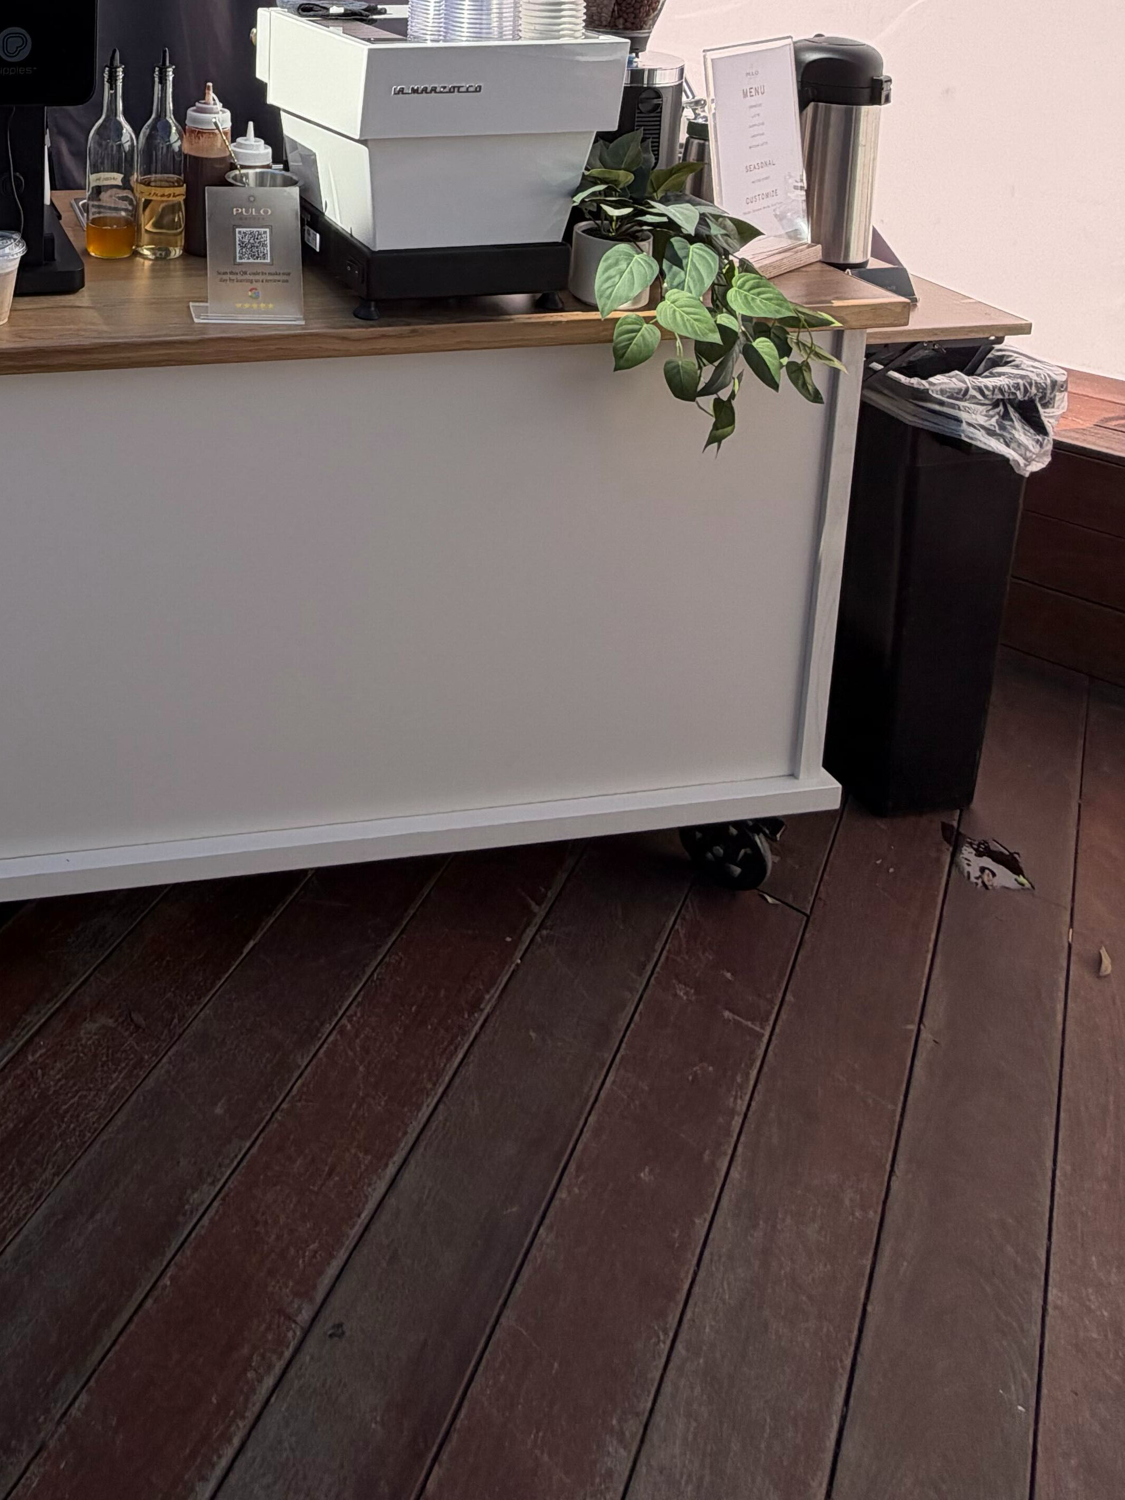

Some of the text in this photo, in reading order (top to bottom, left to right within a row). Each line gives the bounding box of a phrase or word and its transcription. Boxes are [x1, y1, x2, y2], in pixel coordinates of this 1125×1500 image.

[742, 85, 766, 99] MENU
[745, 159, 776, 173] SEASONAL
[745, 189, 778, 205] CUSTOMIZE
[233, 207, 272, 216] PULO
